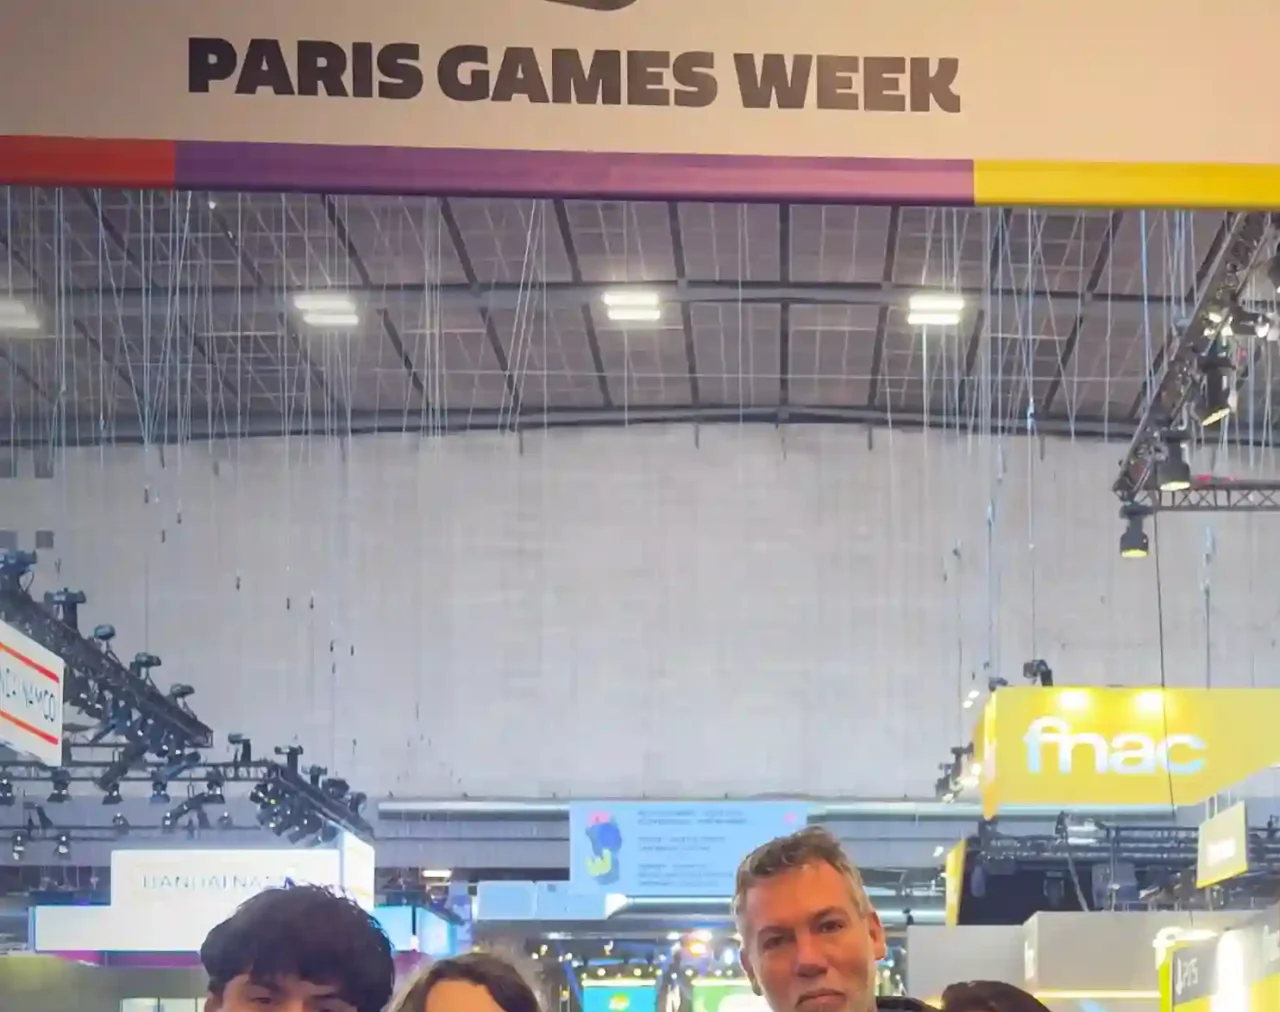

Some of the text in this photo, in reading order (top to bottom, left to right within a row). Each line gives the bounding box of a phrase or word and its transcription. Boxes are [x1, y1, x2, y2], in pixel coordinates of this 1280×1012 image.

[188, 37, 960, 113] PARIS GAMES WEEK
[1022, 715, 1206, 775] fnac
